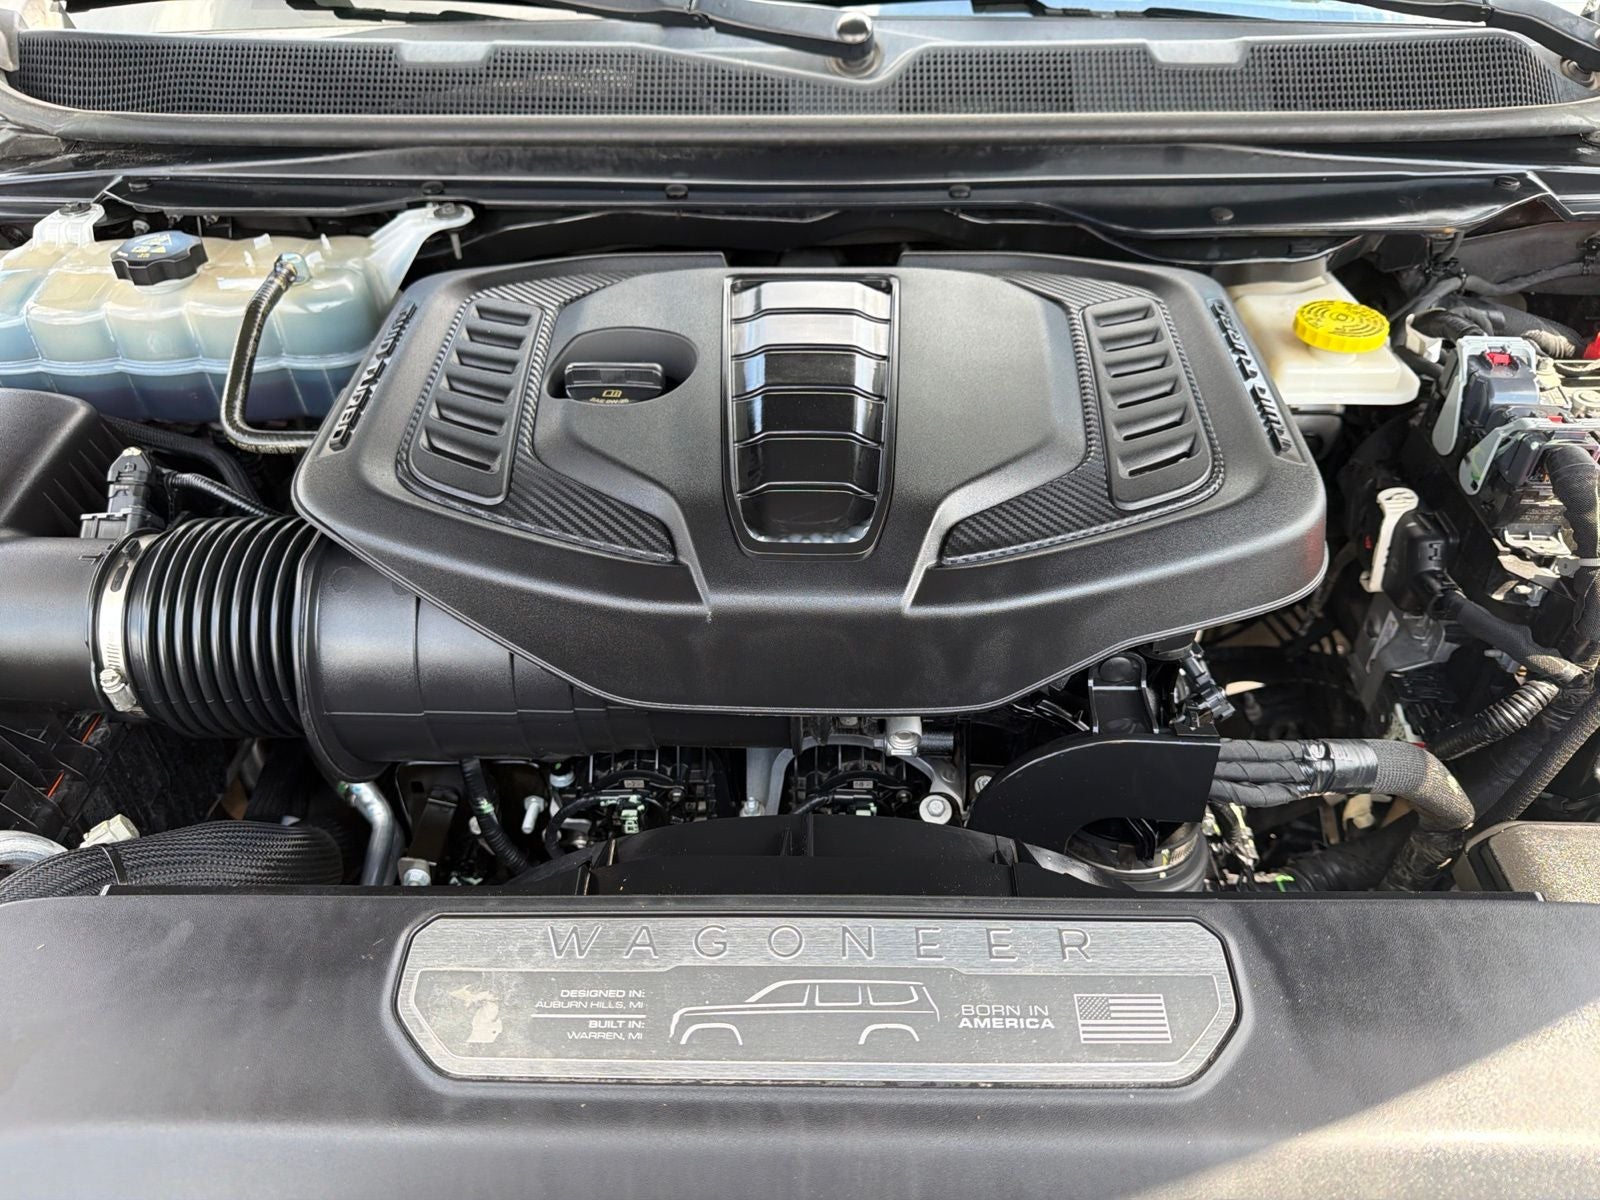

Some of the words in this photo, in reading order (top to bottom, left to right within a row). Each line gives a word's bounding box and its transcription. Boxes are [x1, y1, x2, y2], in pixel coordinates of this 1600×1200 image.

[376, 303, 418, 360] TWIN
[1209, 300, 1258, 382] TURBO
[329, 359, 388, 452] TURBO
[1249, 384, 1292, 456] TWIN
[547, 924, 1093, 962] WAGONEER
[560, 989, 626, 998] DESIGNED
[628, 989, 645, 998] IN:
[535, 1001, 588, 1009] AUBURN
[590, 1001, 626, 1010] HILLS,
[629, 1001, 644, 1009] MI
[961, 1004, 1021, 1016] BORN
[1029, 1005, 1049, 1017] IN
[588, 1020, 626, 1029] BUILT
[628, 1020, 645, 1029] IN:
[958, 1017, 1056, 1029] AMERICA
[567, 1032, 625, 1041] WARREN,
[628, 1032, 643, 1040] MI
